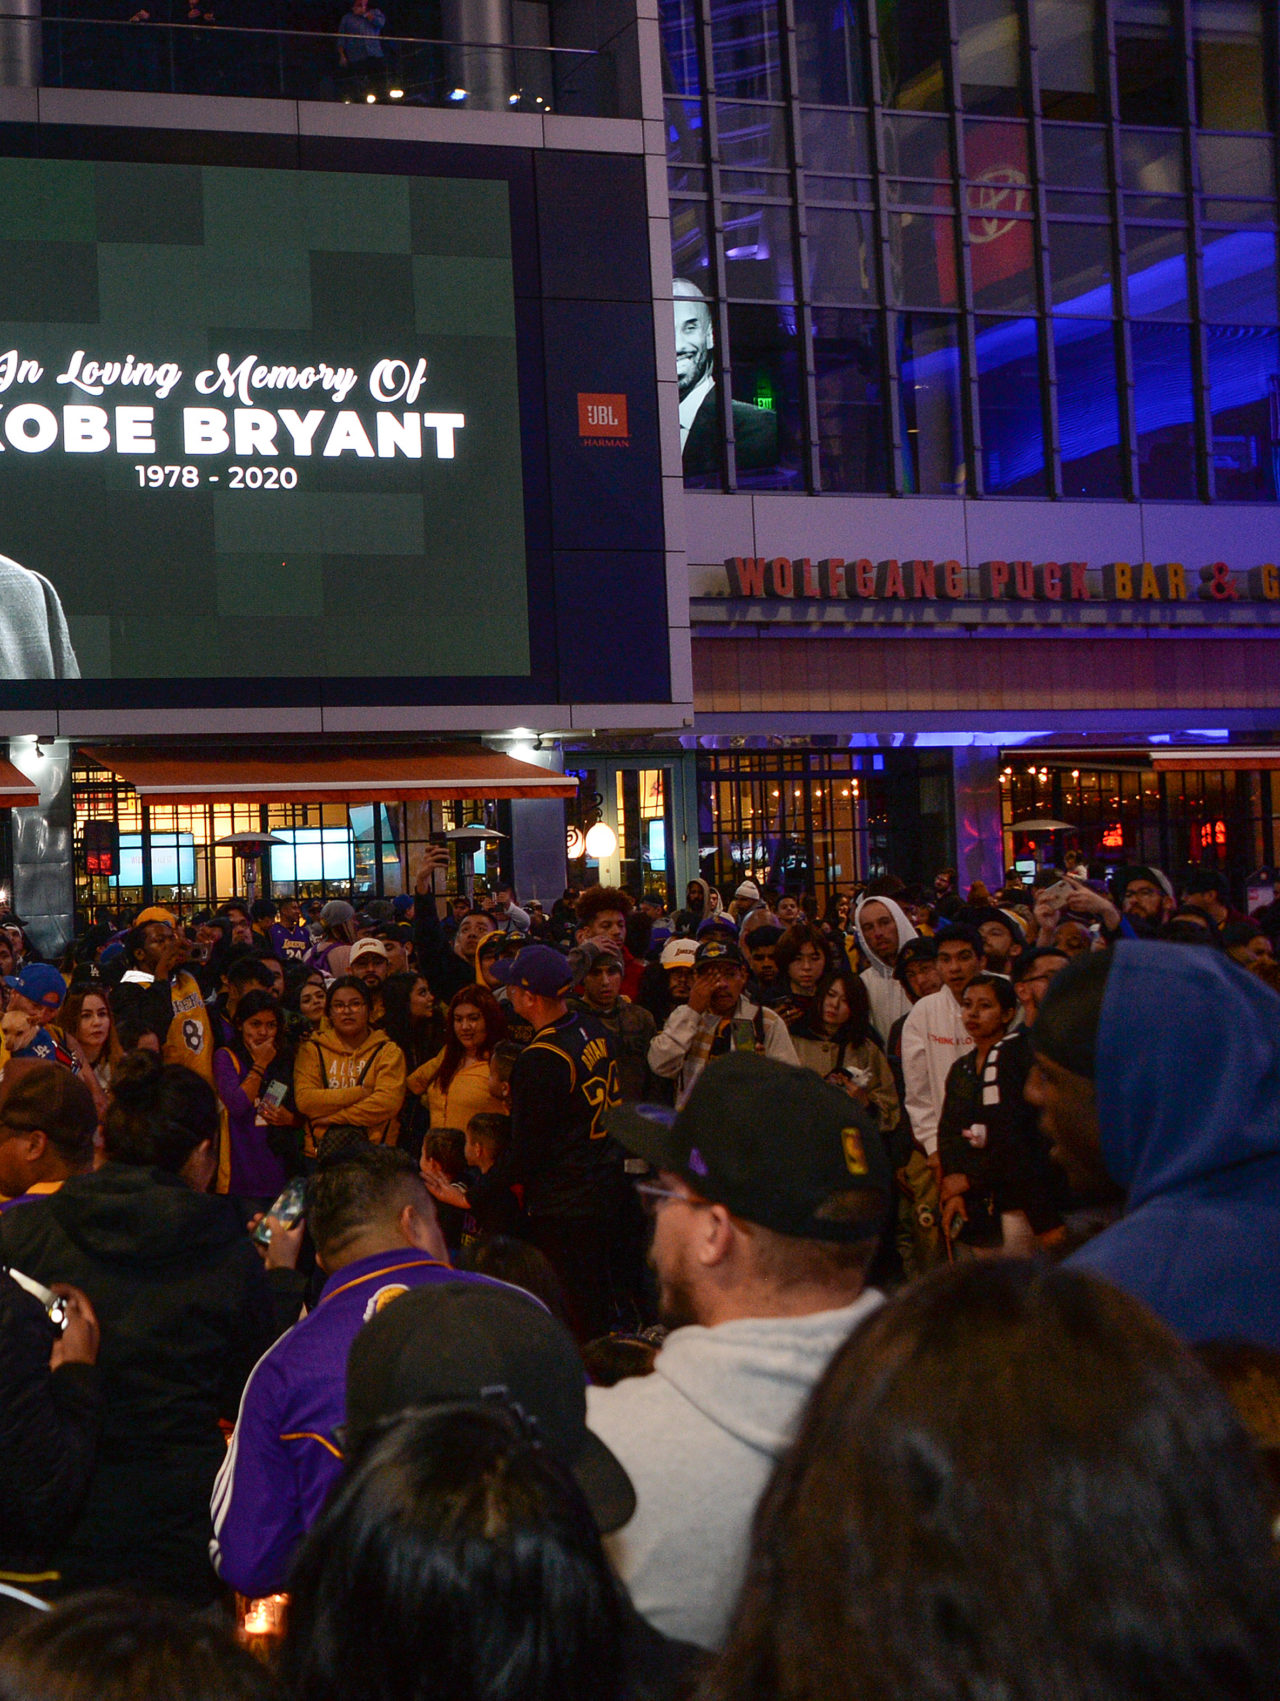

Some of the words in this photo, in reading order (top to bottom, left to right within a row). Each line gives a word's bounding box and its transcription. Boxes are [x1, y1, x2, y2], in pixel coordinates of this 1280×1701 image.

[56, 350, 183, 399] Loving
[195, 353, 358, 405] Memory
[369, 358, 427, 404] Of
[586, 405, 619, 425] JBL
[183, 407, 465, 459] BRYANT
[584, 438, 631, 448] HARMAN
[135, 464, 200, 488] 1978
[228, 466, 298, 489] 2020
[726, 556, 965, 599] WOLFGANG
[981, 560, 1091, 599] PUCK
[1106, 561, 1187, 600] BAR
[1204, 561, 1240, 600] &
[183, 1019, 203, 1054] 8
